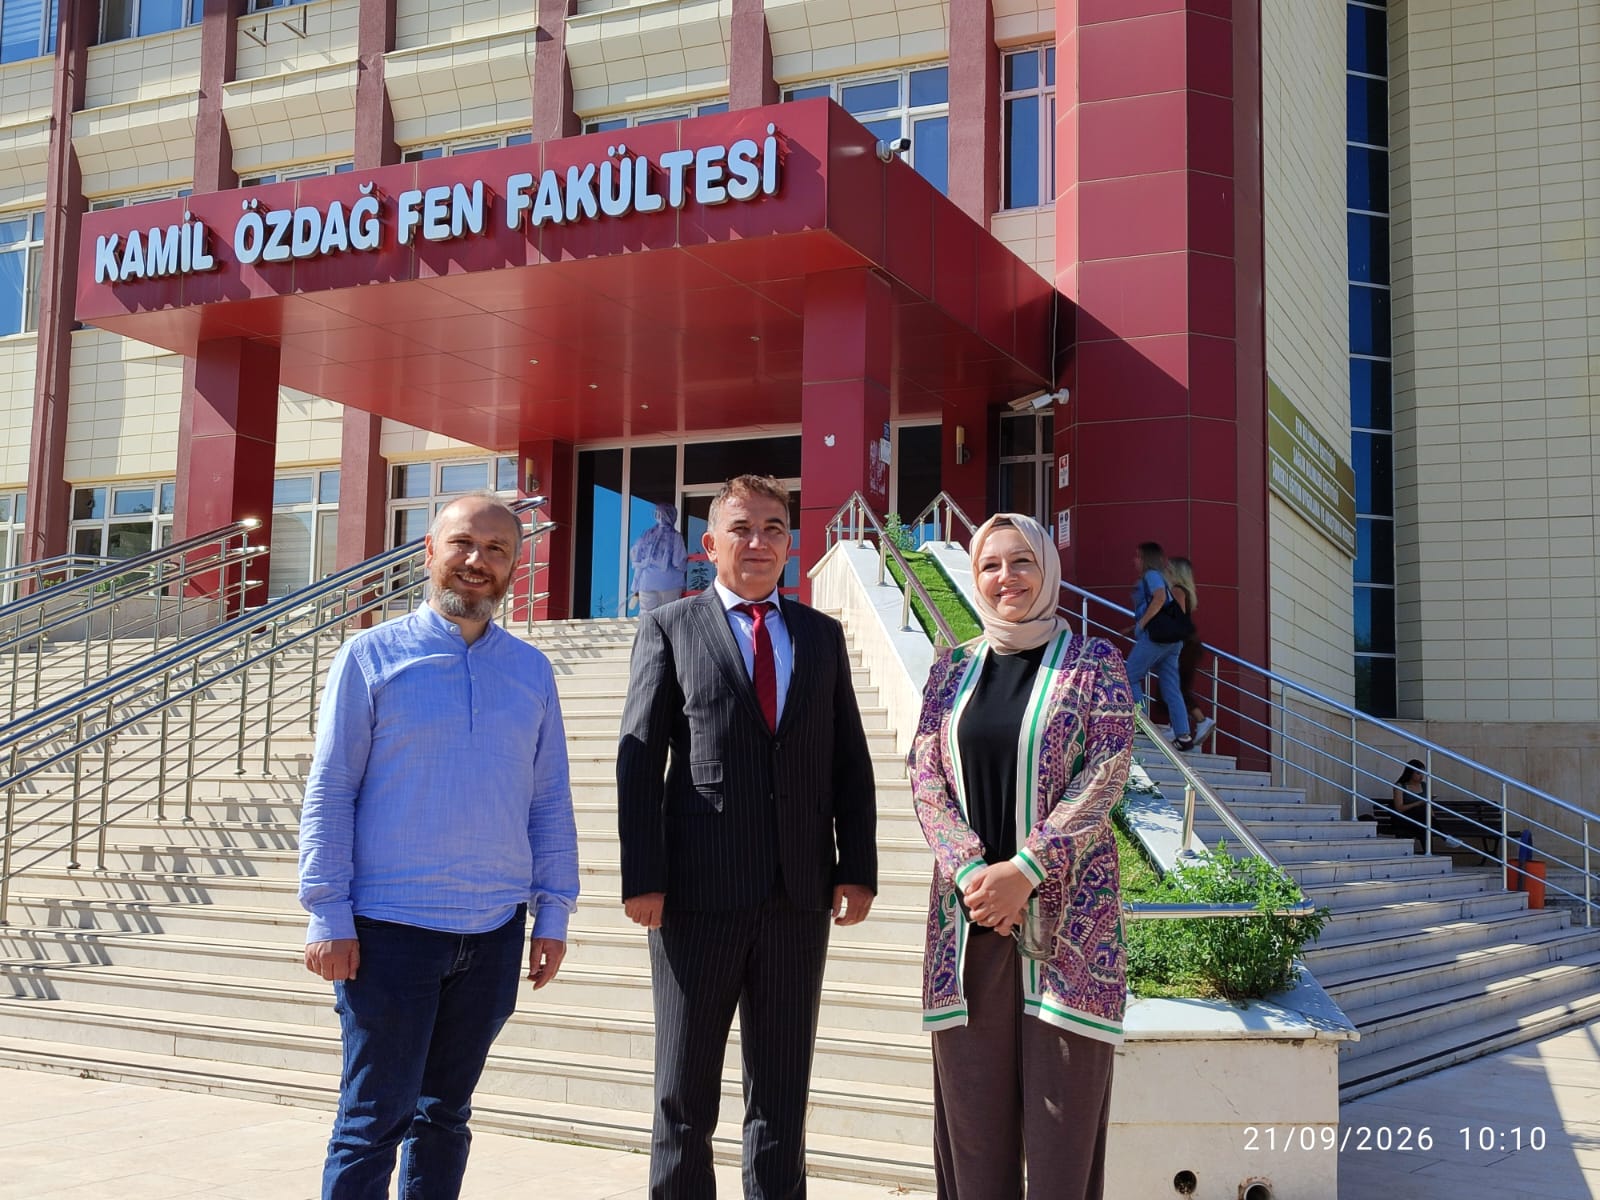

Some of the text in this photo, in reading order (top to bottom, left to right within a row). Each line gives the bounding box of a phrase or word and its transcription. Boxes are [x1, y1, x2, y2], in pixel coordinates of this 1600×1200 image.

[95, 123, 778, 283] KAMİL ÖZDAĞ FEN FAKÜLTESİ
